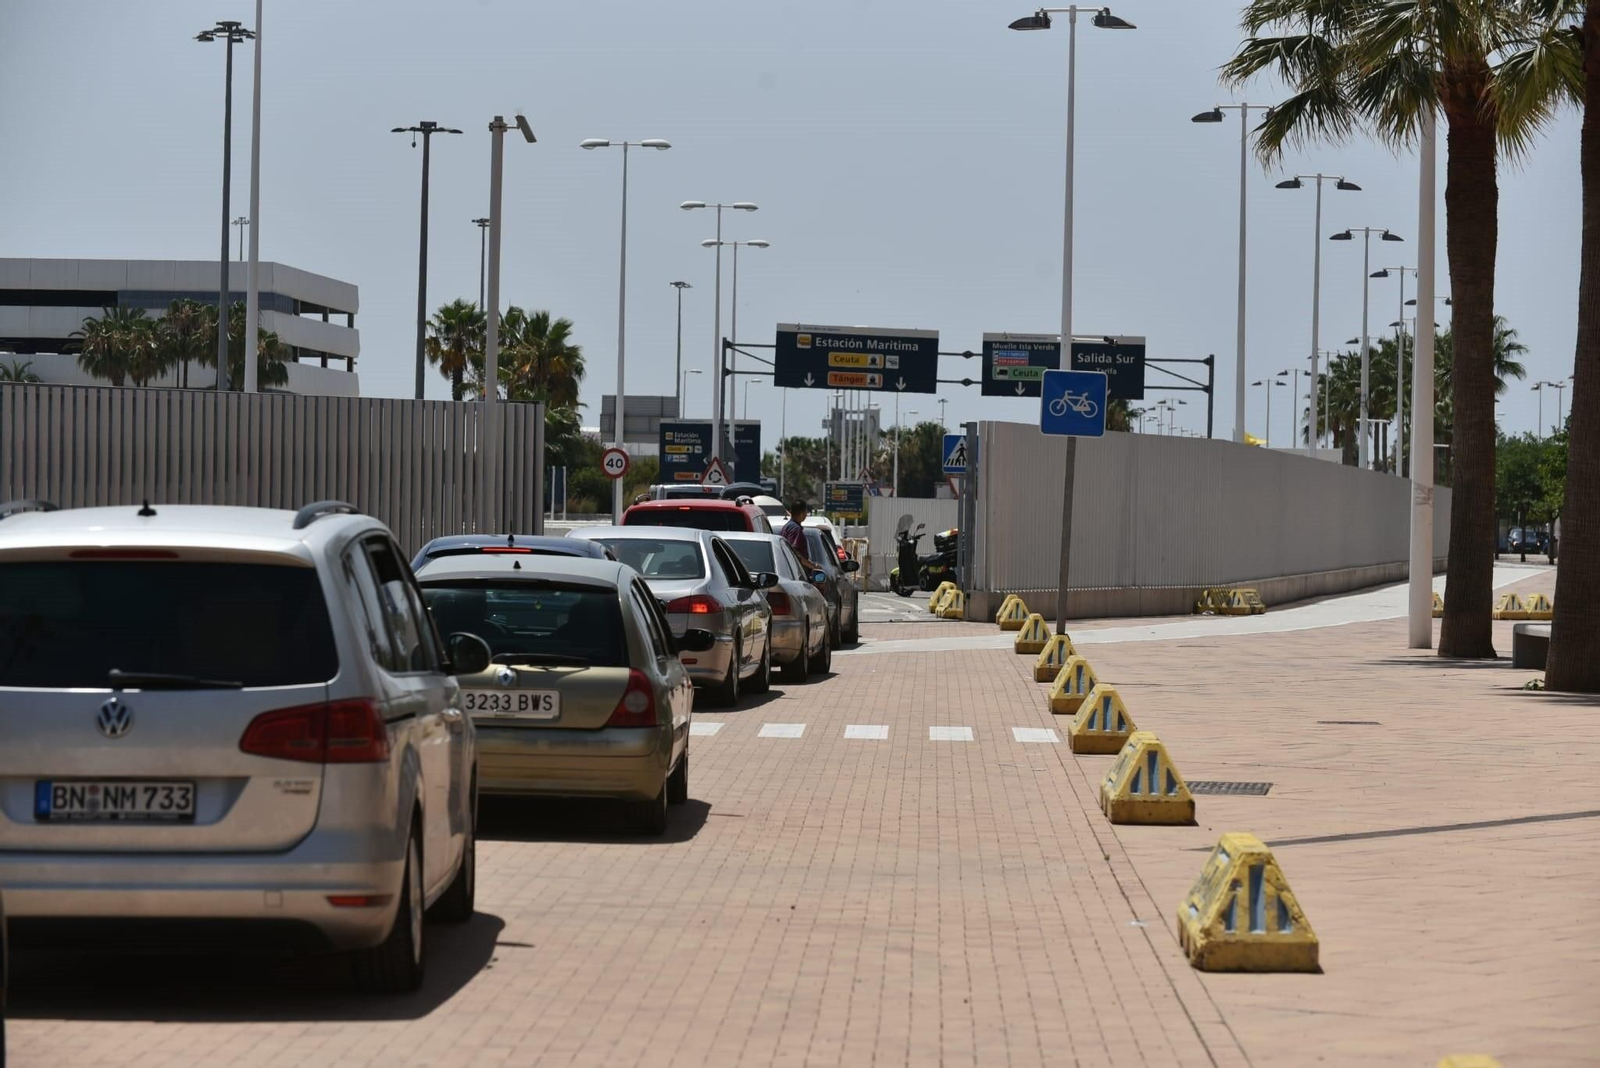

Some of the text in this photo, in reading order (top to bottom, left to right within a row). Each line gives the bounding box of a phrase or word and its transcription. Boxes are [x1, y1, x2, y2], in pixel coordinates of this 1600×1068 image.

[815, 337, 863, 349] Estación
[833, 355, 860, 363] Ceuta
[1077, 353, 1135, 364] Salida Sur
[1012, 369, 1039, 377] Ceuta
[606, 458, 623, 469] 40
[465, 693, 552, 711] 3233 BWS
[52, 786, 190, 811] BN NM 733
